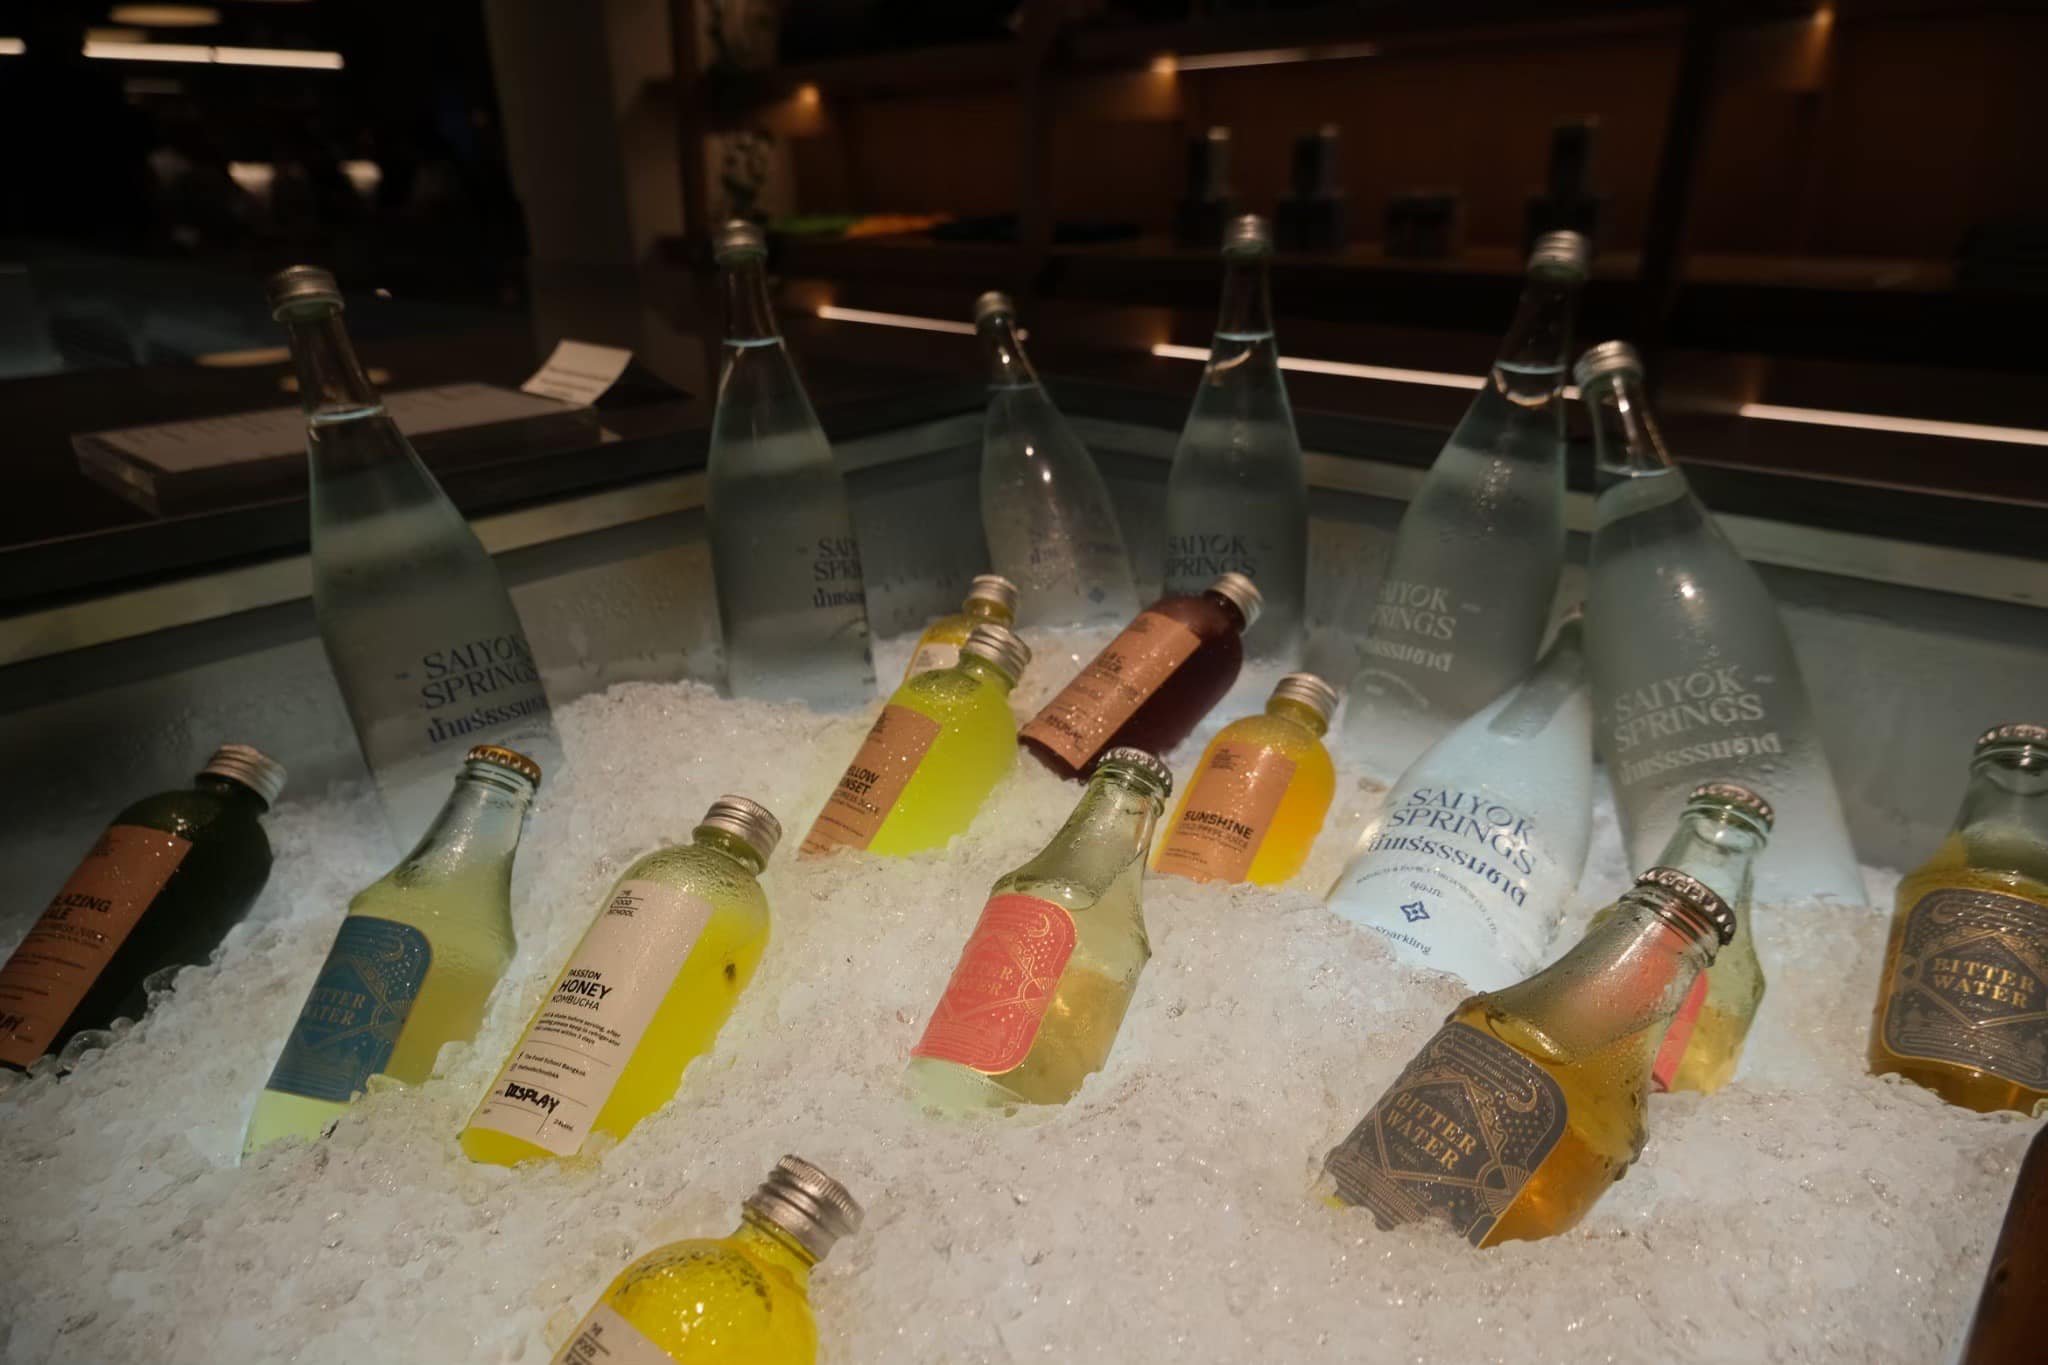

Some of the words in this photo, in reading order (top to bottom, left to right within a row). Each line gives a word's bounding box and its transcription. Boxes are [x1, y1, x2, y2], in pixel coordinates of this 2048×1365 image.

[1614, 668, 1745, 722] SAIYOK
[1613, 692, 1765, 753] SPRINGS
[1183, 810, 1254, 840] SUNSHINE
[1407, 788, 1535, 845] SAIYOK
[1386, 808, 1536, 875] SPRINGS
[558, 979, 613, 999] HONEY
[568, 969, 602, 981] PASSION
[1934, 958, 2036, 993] BITTER
[1934, 973, 2028, 1009] WATER
[551, 995, 600, 1011] KOMBUCHA
[504, 1083, 560, 1114] DISPLAY
[1385, 1107, 1461, 1169] WATER
[1395, 1091, 1478, 1157] BITTER
